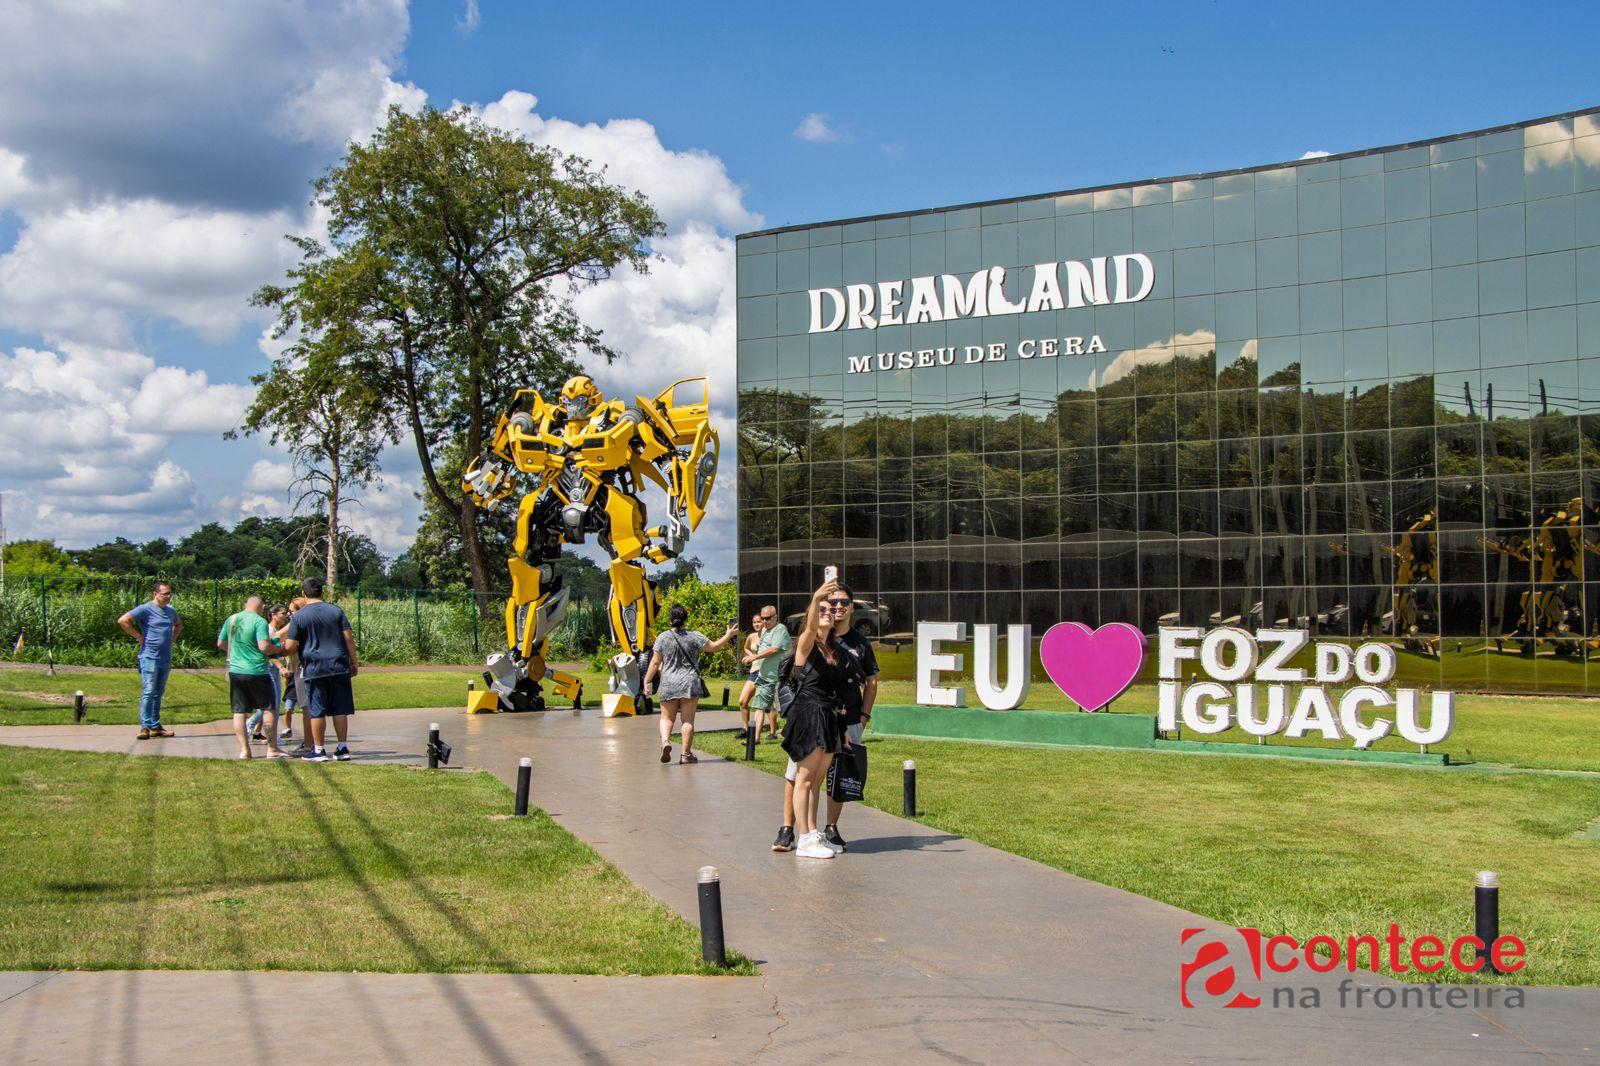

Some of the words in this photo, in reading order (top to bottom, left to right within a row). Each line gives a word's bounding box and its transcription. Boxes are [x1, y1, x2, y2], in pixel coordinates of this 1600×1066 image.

[808, 252, 1155, 334] DREAMLAND
[848, 347, 957, 375] MUSEU
[964, 343, 1008, 364] DE
[1017, 335, 1108, 360] CERA
[916, 621, 1031, 710] EU
[1158, 626, 1309, 682] FOZ
[1315, 641, 1397, 683] DO
[1158, 681, 1456, 749] IGUAÇU
